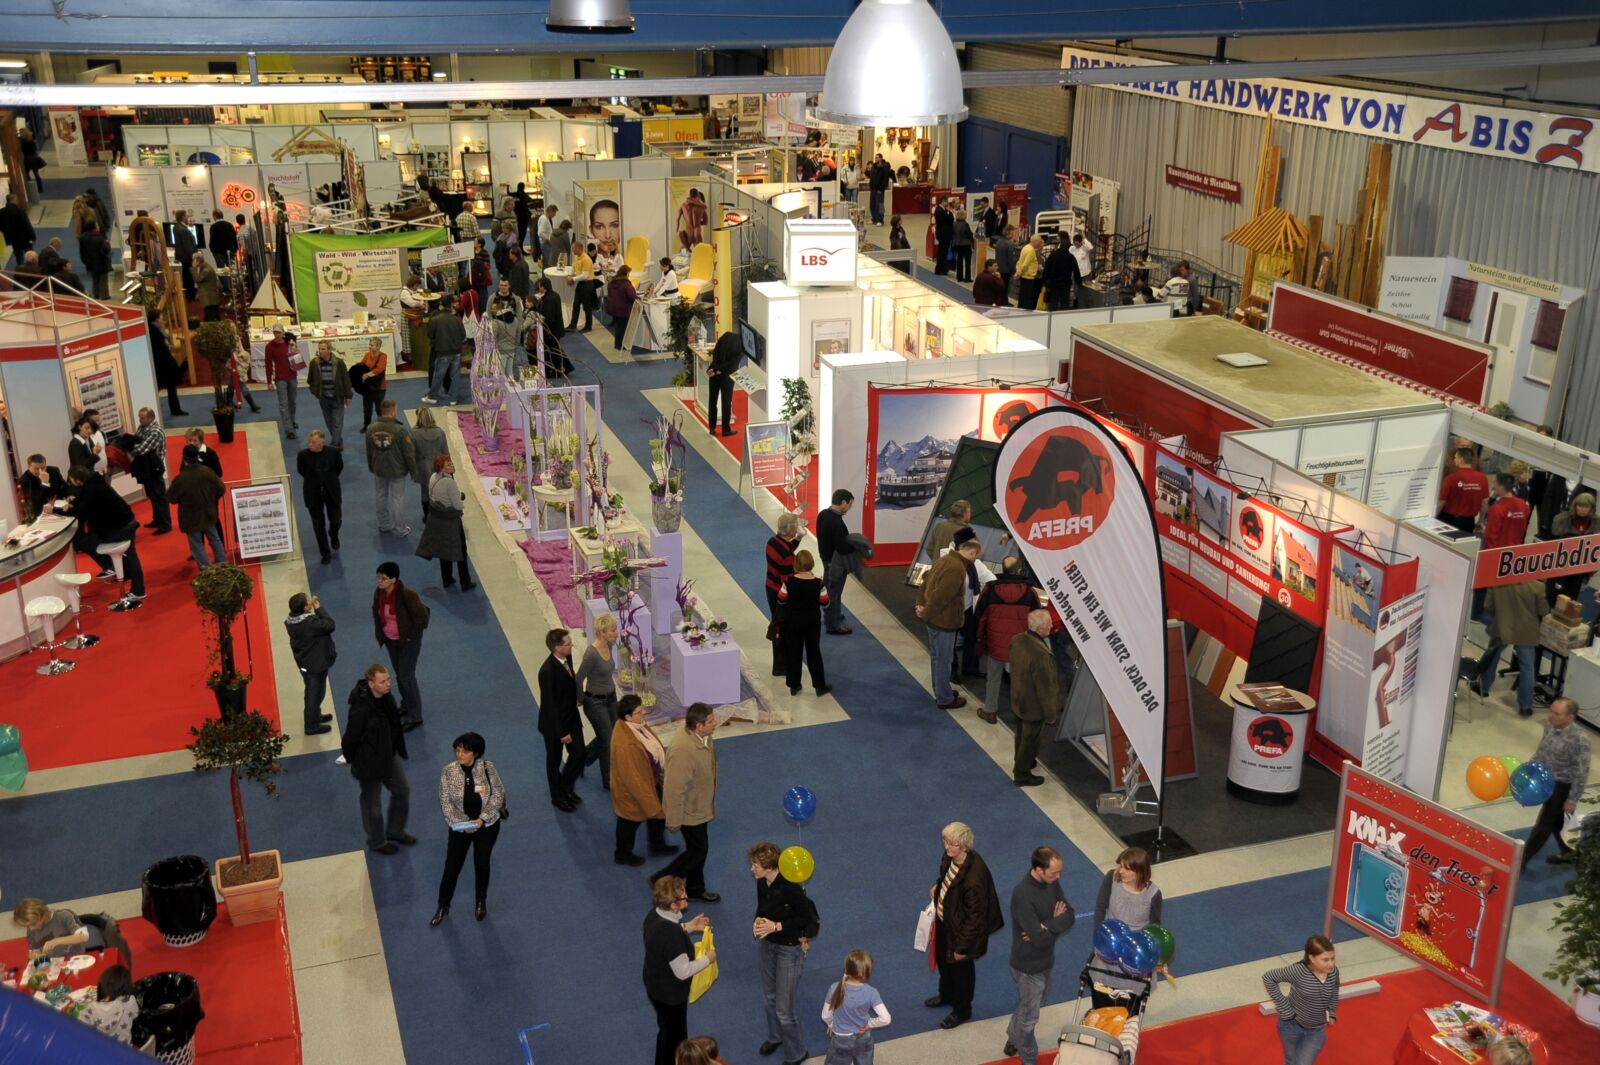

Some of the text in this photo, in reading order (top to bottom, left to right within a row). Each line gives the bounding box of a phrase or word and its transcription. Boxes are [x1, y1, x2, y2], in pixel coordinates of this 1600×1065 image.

[1188, 79, 1331, 122] HANDWERK
[1340, 96, 1405, 134] VON
[1413, 103, 1468, 143] A
[1469, 114, 1533, 154] BIS
[1535, 117, 1594, 170] Z
[675, 130, 699, 141] Ofen
[801, 255, 828, 266] LBS
[1389, 274, 1437, 284] Naturstein
[1468, 263, 1507, 280] Natursteine
[1508, 273, 1522, 284] und
[1523, 278, 1559, 293] Grabmale
[1383, 343, 1408, 359] Börner
[1305, 458, 1365, 471] Feuchtigkeitsursachen
[1169, 524, 1187, 542] IDEAL
[1187, 532, 1199, 548] FÜR
[1199, 540, 1222, 562] NEUBAU
[1221, 555, 1235, 570] UND
[1235, 563, 1271, 593] SANIERUNG!
[1253, 744, 1283, 755] PREFA
[1347, 809, 1407, 854] KNAX
[1409, 844, 1499, 896] den Tresr
